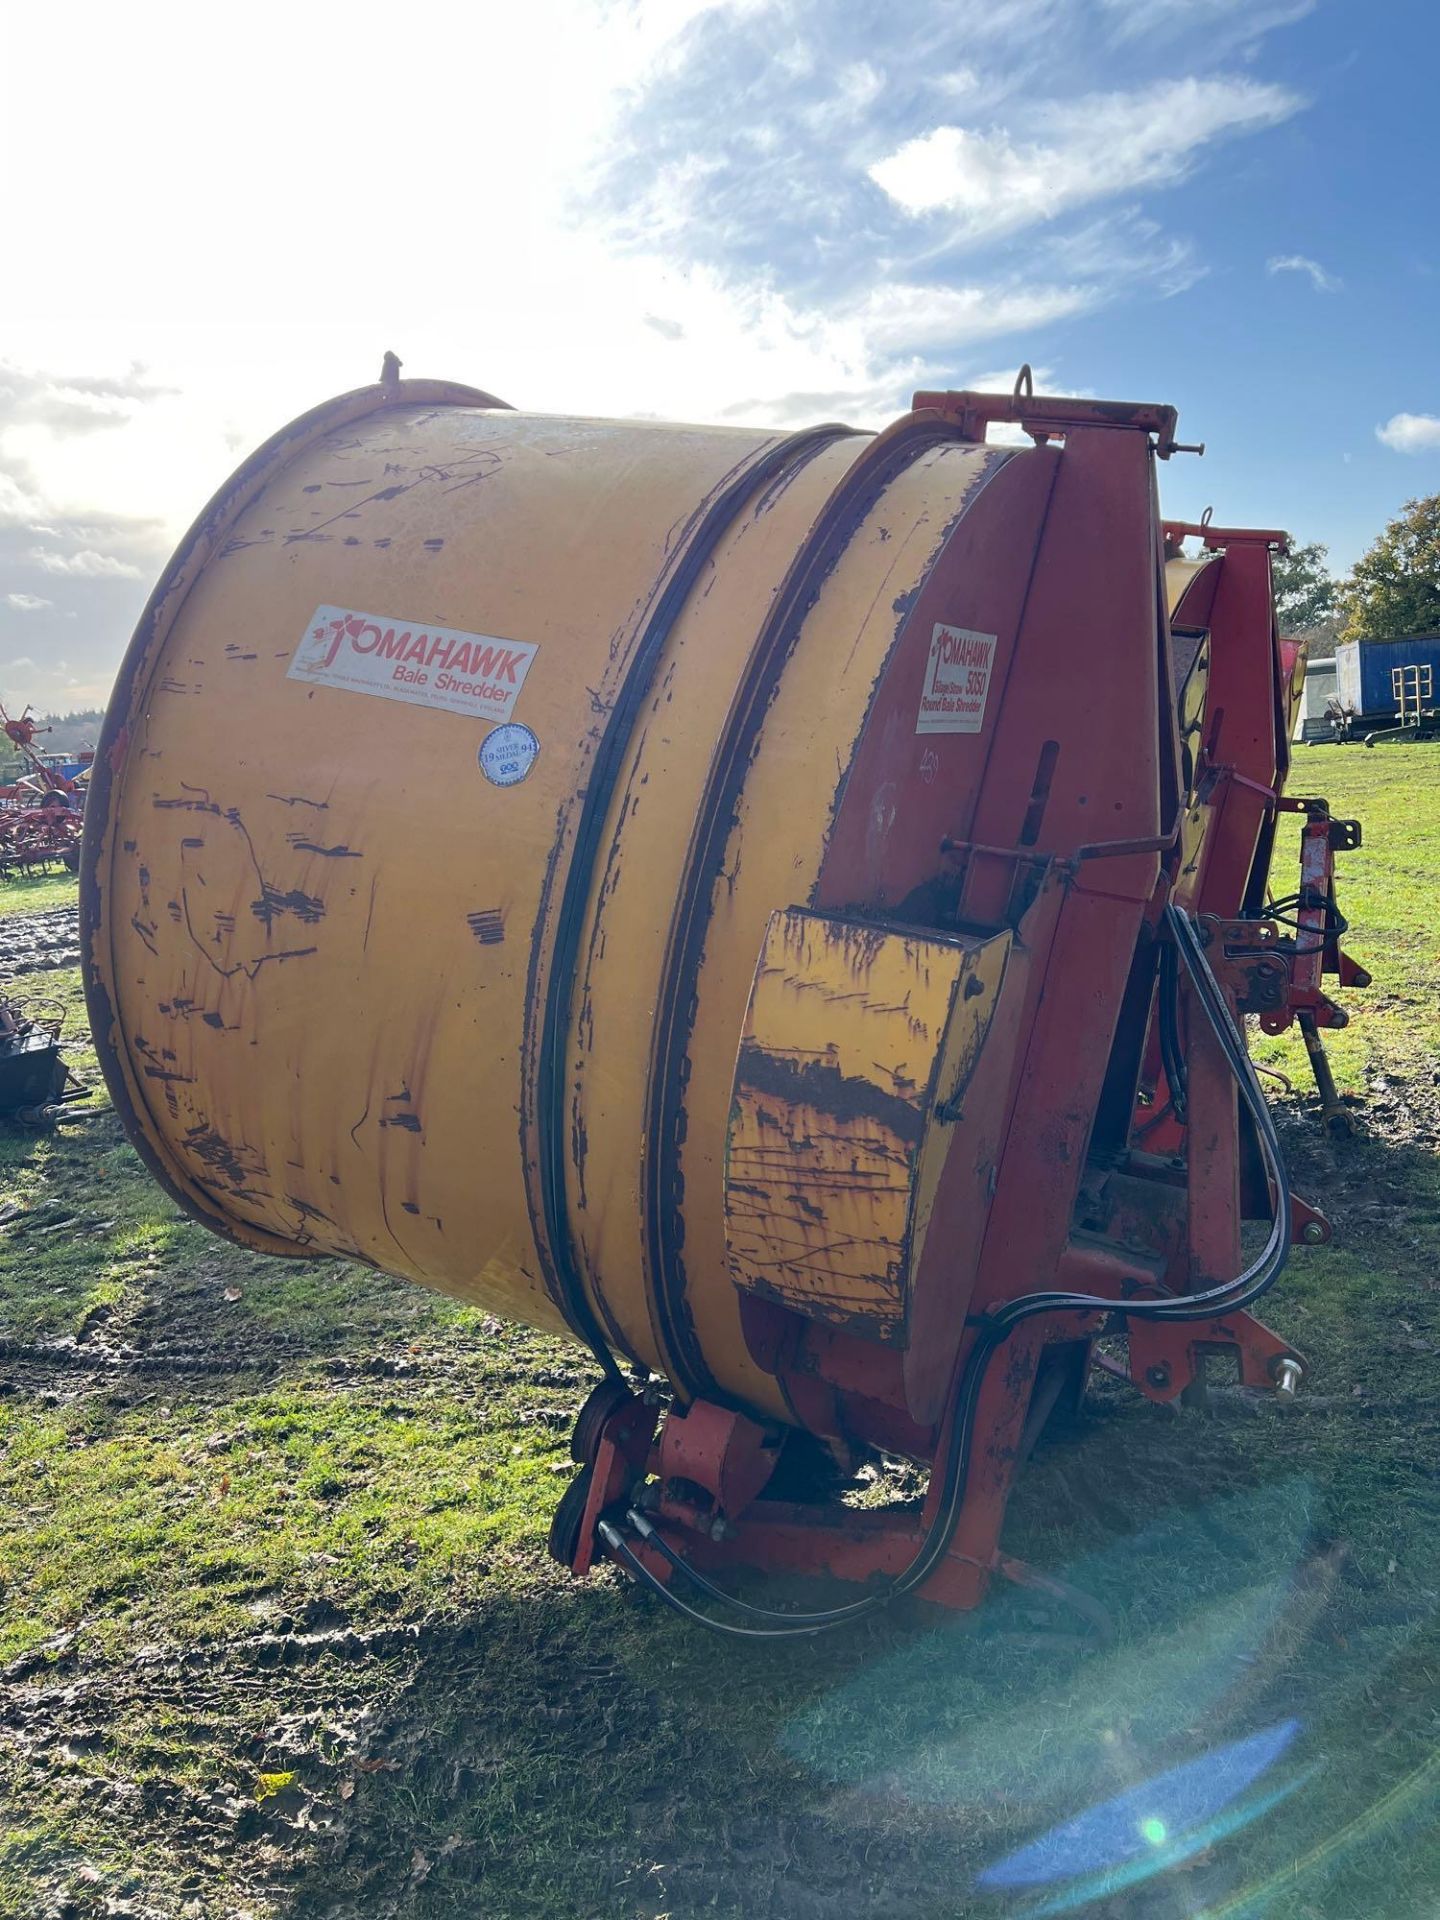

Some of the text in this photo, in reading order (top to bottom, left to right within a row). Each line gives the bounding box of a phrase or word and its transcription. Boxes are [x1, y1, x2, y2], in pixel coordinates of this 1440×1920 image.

[324, 614, 528, 684] TOMAHAWK
[932, 629, 992, 694] TOMAHAWK
[391, 665, 429, 685] Bale
[434, 672, 513, 704] Shredder
[965, 671, 987, 696] 5050
[921, 696, 981, 713] Round Bale Shredder
